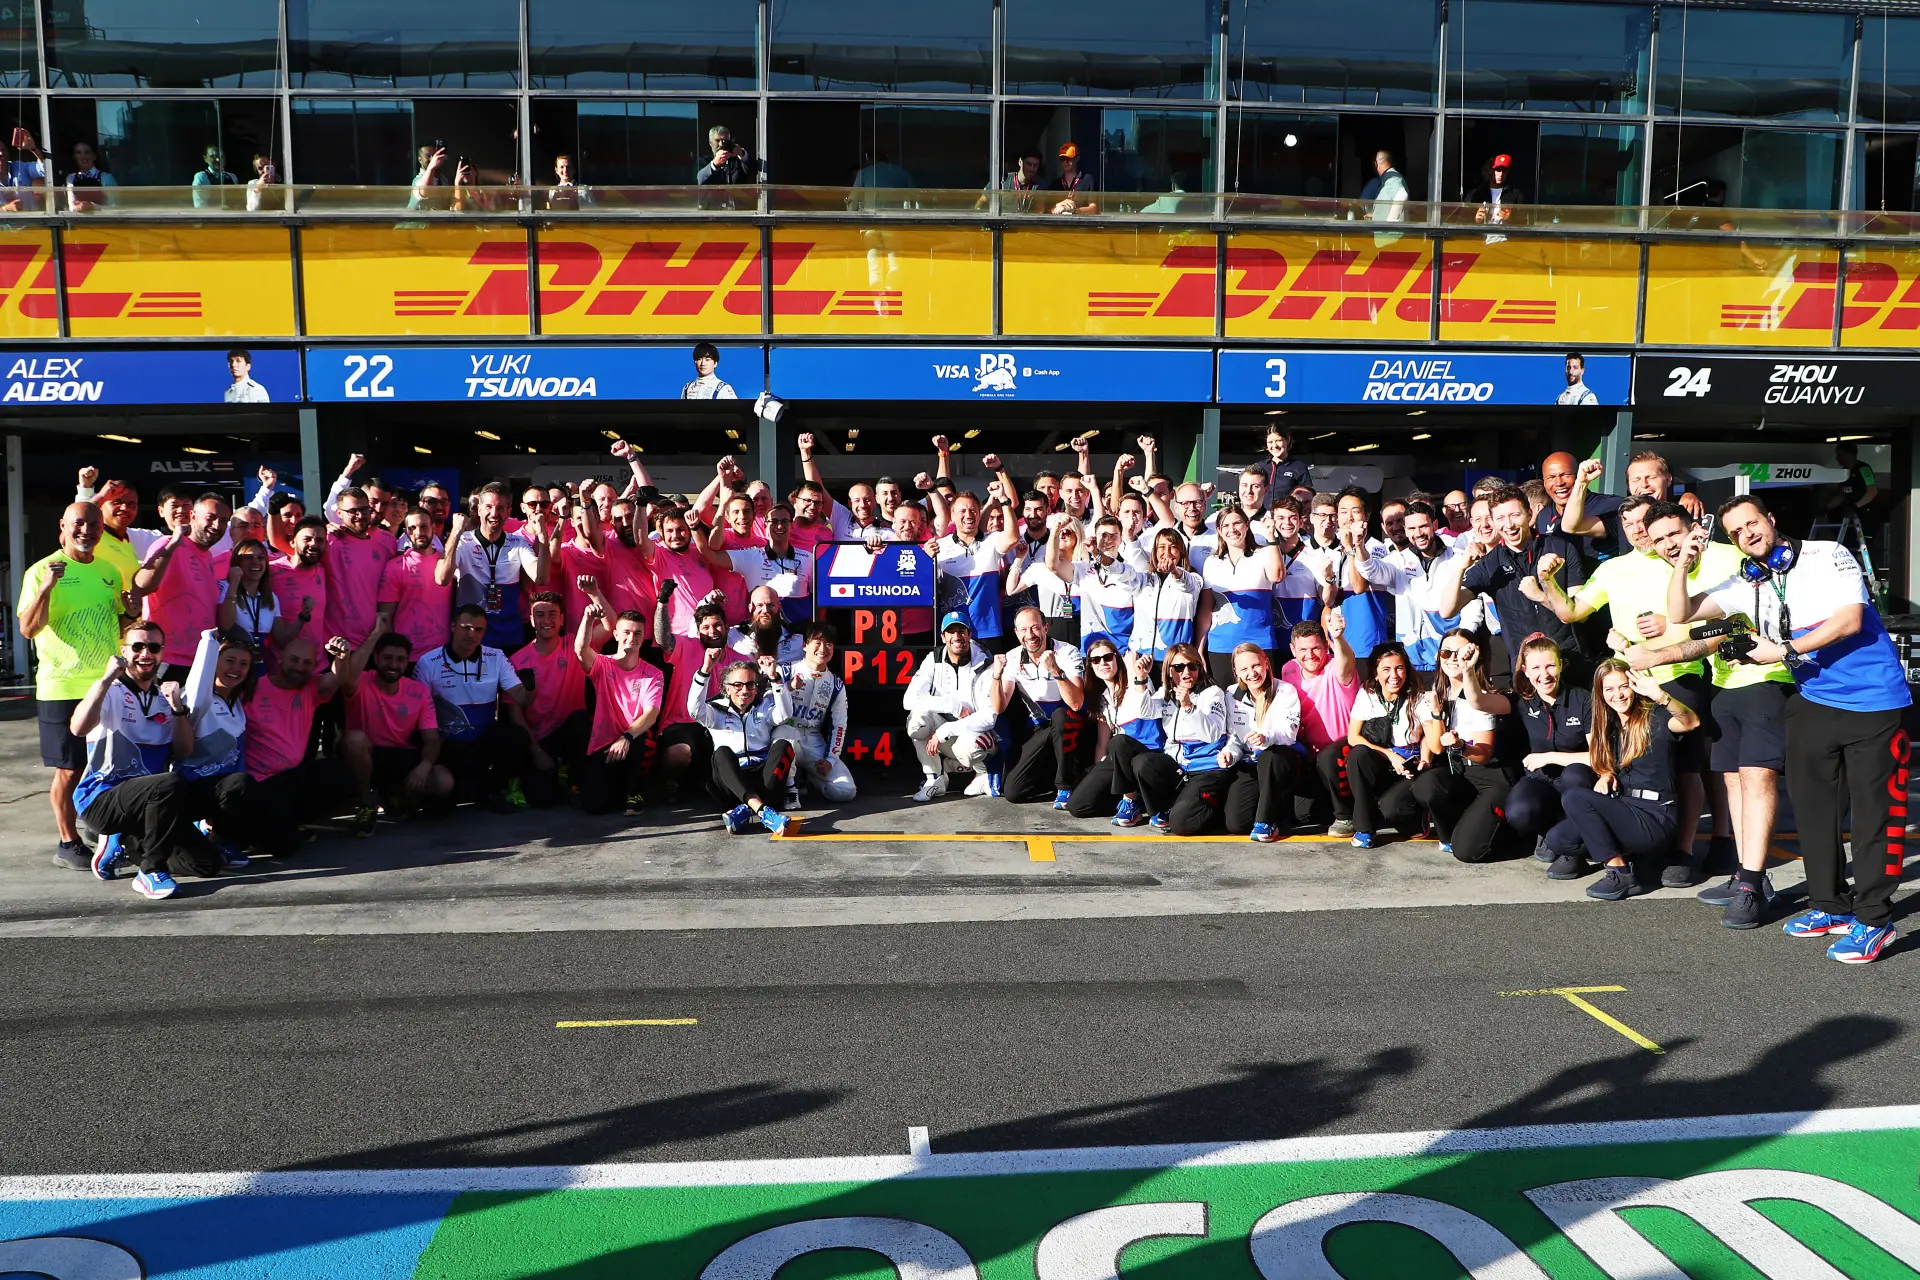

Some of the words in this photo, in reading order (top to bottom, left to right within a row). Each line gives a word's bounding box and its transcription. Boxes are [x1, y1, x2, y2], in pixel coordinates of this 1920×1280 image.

[464, 241, 837, 316] DHL
[1155, 246, 1497, 323] DHL
[7, 358, 83, 379] ALEX
[470, 354, 532, 375] YUKI
[932, 364, 970, 379] VISA
[980, 353, 1018, 378] RB
[1033, 368, 1048, 376] Cash
[1048, 368, 1060, 377] App
[1368, 360, 1456, 379] DANIEL
[1769, 364, 1838, 384] ZHOU
[344, 355, 395, 398] 22
[1264, 358, 1287, 398] 3
[1663, 366, 1712, 398] 24
[2, 381, 104, 402] ALBON
[465, 377, 597, 398] TSUNODA
[1362, 381, 1494, 402] RICCIARDO
[1764, 385, 1866, 405] GUANYU
[150, 460, 212, 473] ALEX
[1738, 463, 1771, 483] 24
[1775, 468, 1812, 479] ZHOU
[593, 474, 614, 482] VISA
[857, 585, 921, 596] TSUNODA
[1702, 628, 1724, 638] DEITY
[793, 702, 824, 721] VISA
